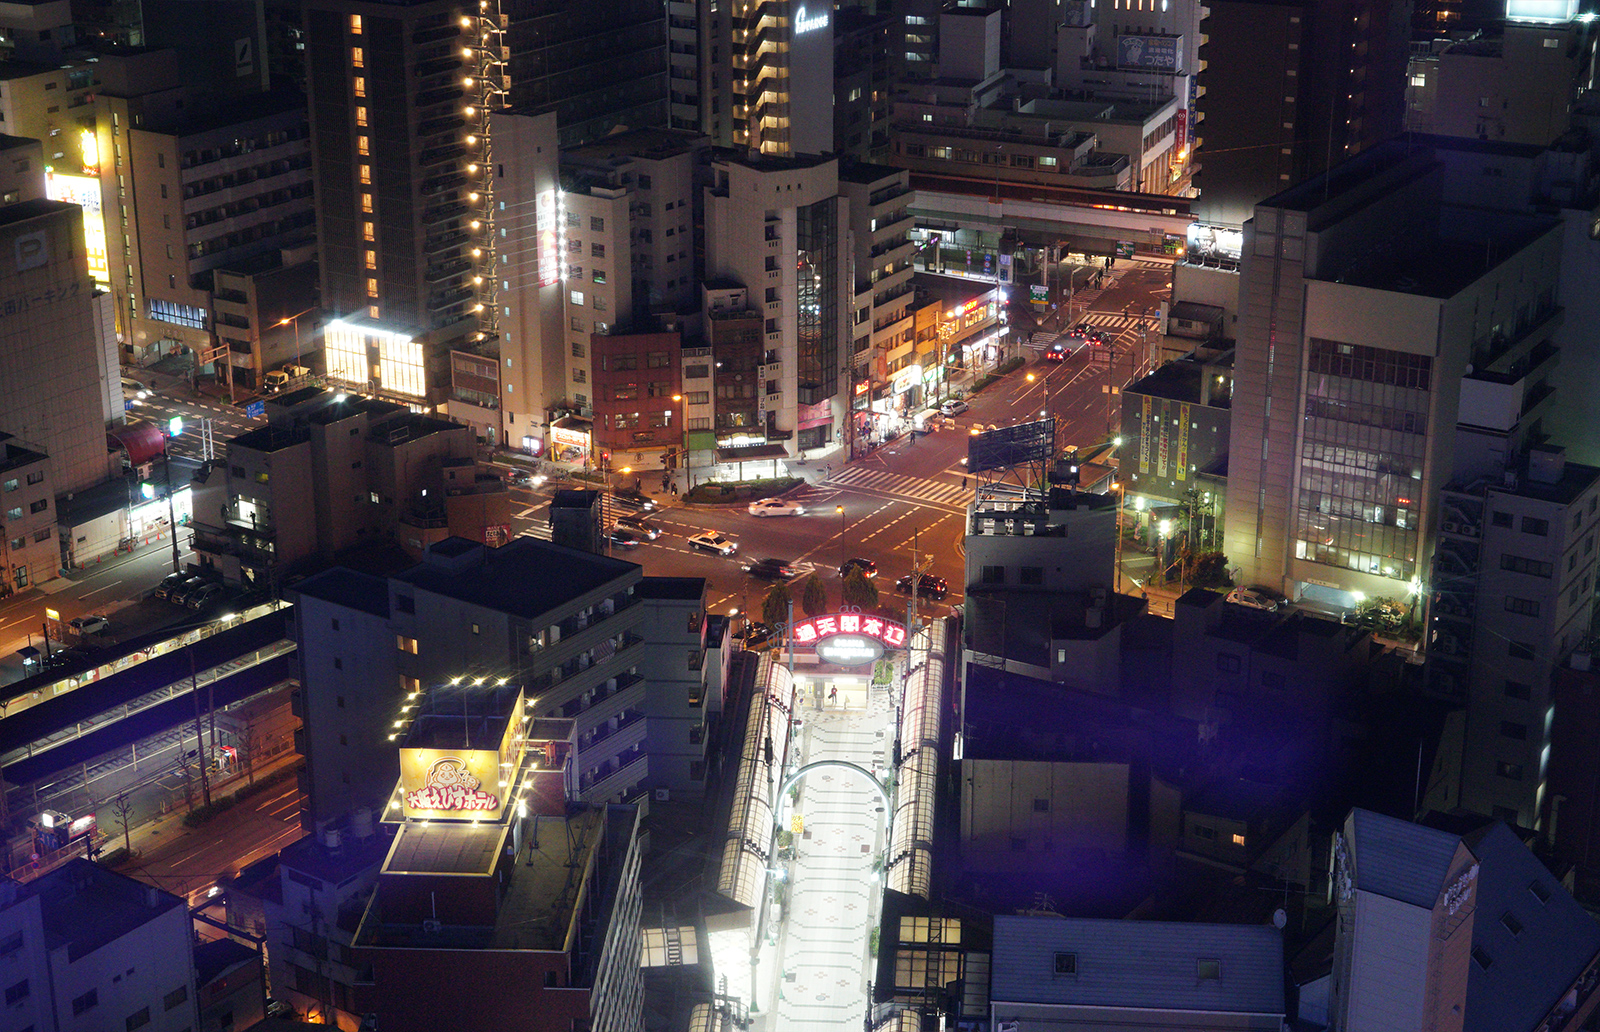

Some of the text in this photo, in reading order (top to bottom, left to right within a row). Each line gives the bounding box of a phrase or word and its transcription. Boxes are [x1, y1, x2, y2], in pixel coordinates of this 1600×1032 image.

[1144, 54, 1175, 67] つたや
[20, 239, 42, 265] P
[0, 283, 81, 317] 田パーキング
[795, 615, 905, 646] 通天閣本通
[405, 786, 498, 811] 大阪えびすホテル
